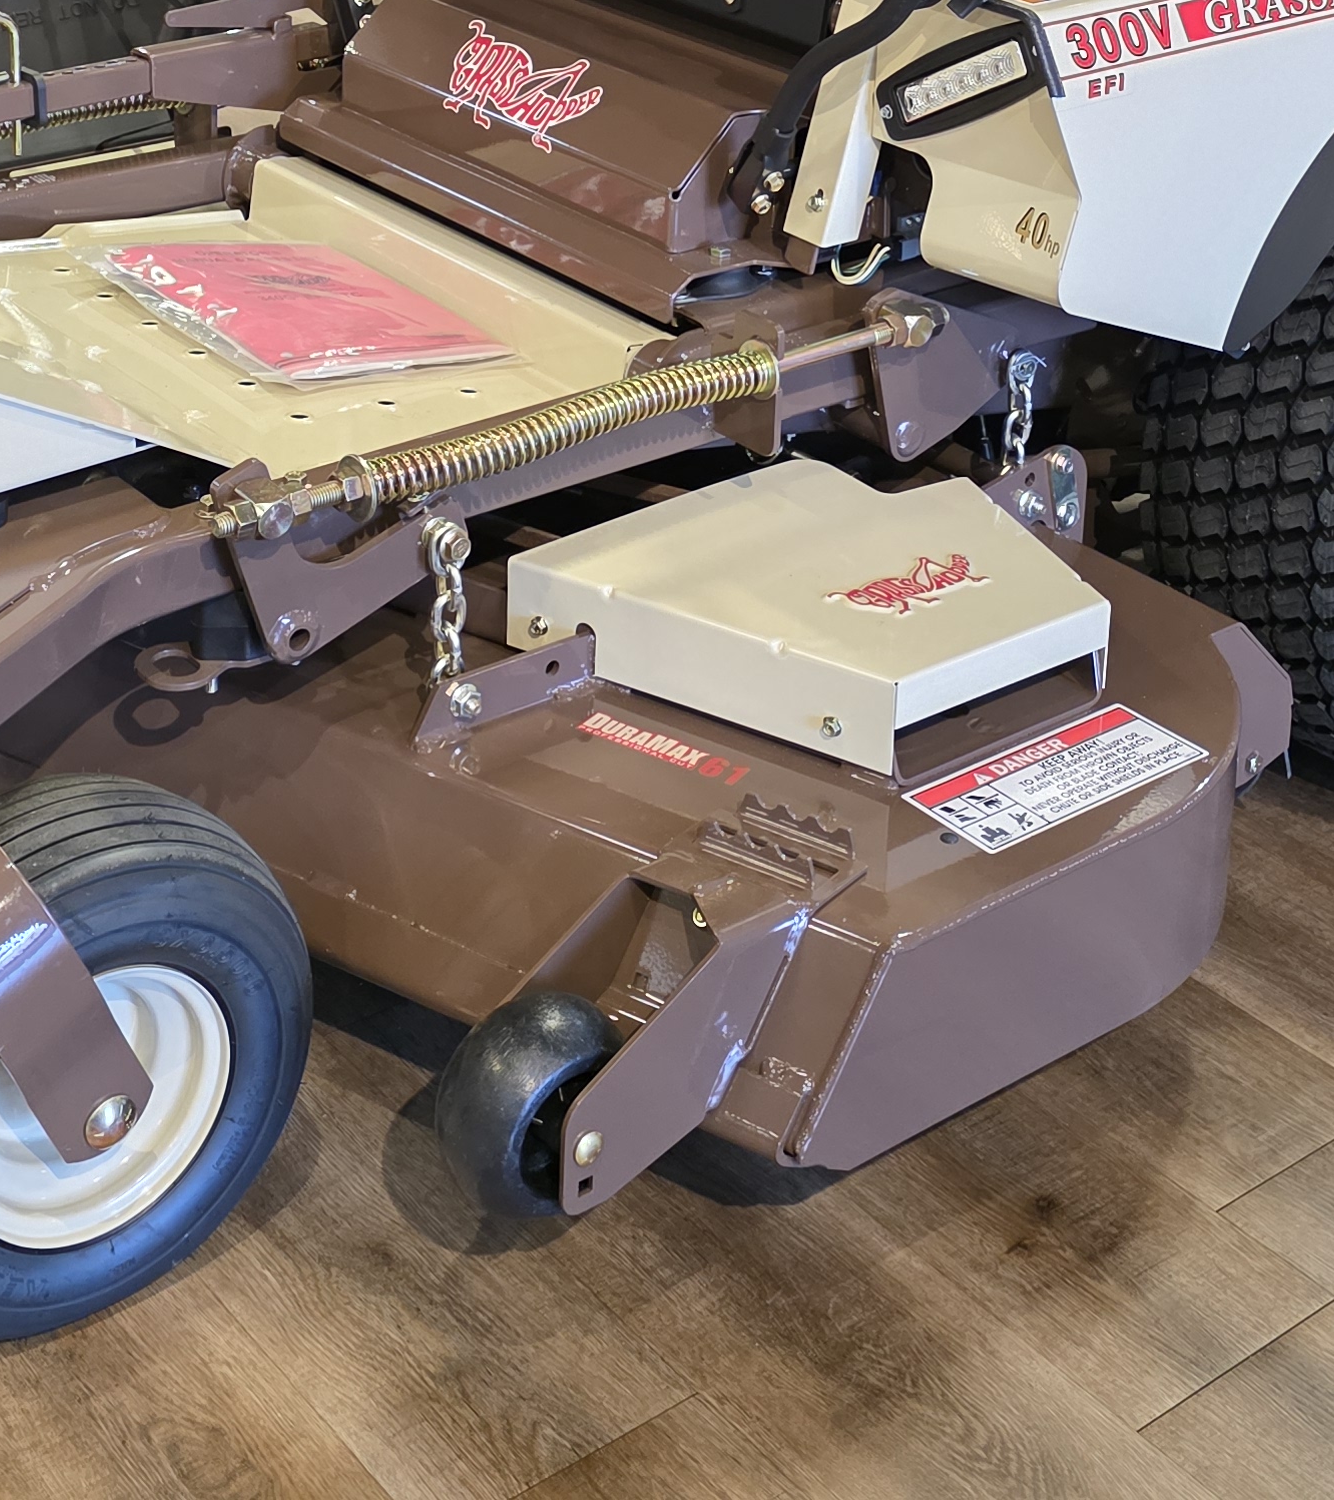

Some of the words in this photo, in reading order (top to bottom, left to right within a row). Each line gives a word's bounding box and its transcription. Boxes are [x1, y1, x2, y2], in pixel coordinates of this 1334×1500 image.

[1065, 3, 1171, 70] 300V
[1088, 72, 1125, 99] EFI
[577, 724, 665, 760] PROFESSIONAL
[669, 757, 697, 770] CUT
[988, 738, 1069, 777] DANGER
[1018, 778, 1034, 787] TO
[1034, 766, 1063, 782] AVOID
[1062, 751, 1098, 771] SERIOUS
[1096, 738, 1126, 755] INJURY
[1125, 731, 1141, 741] OR
[1024, 779, 1055, 795] DEATH
[1052, 768, 1081, 784] FROM
[1078, 750, 1118, 771] THROWN
[1116, 735, 1154, 754] OBJECTS
[1037, 754, 1065, 770] KEEP
[1067, 738, 1106, 758] AWAY!
[698, 755, 751, 786] 61
[1031, 795, 1062, 812] NEVER
[1060, 779, 1100, 799] OPERATE
[1097, 762, 1136, 782] WITHOUT
[1134, 741, 1184, 766] DISCHARGE
[1049, 798, 1080, 813] CHUTE
[1078, 790, 1095, 801] OR
[1091, 782, 1115, 794] SIDE
[1111, 767, 1146, 786] SHIELDS
[1143, 761, 1157, 771] IN
[1056, 781, 1072, 791] OR
[1072, 768, 1100, 786] BLADE
